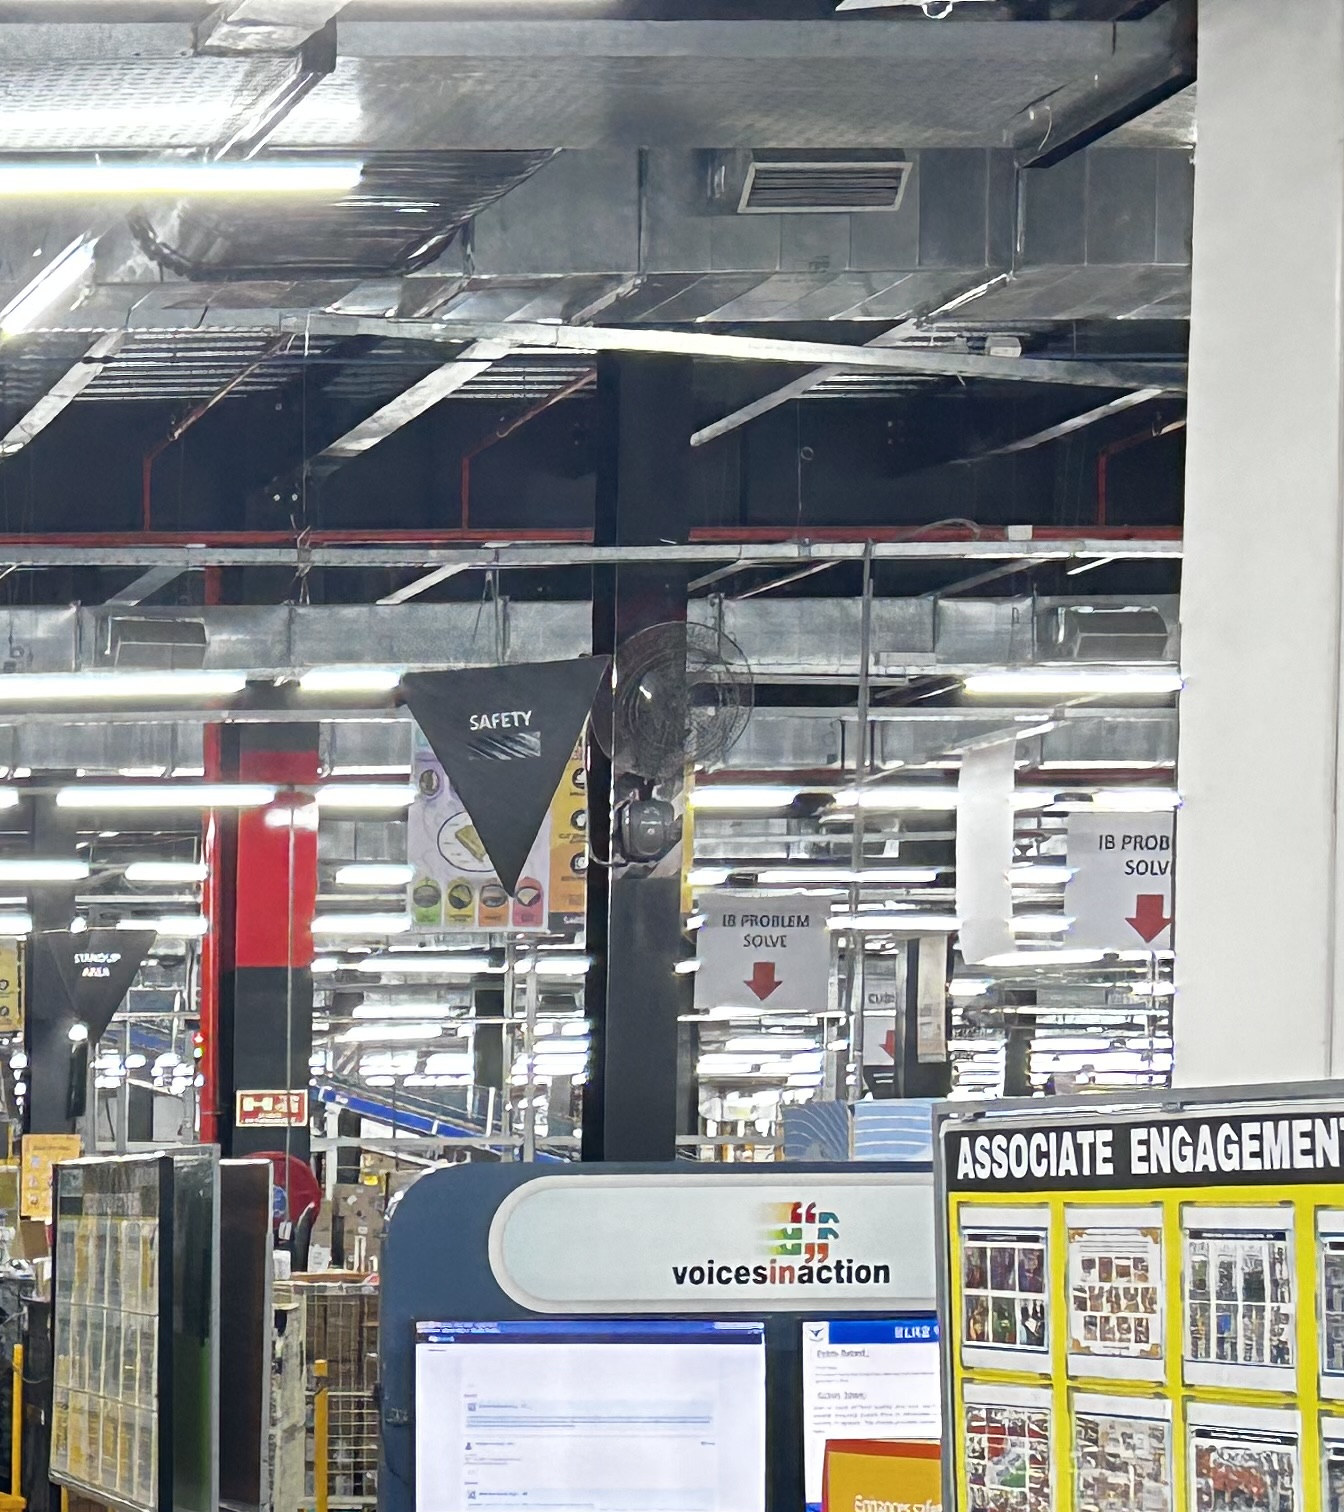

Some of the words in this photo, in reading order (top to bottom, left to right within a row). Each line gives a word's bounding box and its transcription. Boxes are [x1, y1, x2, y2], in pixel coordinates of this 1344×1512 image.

[469, 710, 532, 731] SAFETY
[1098, 834, 1115, 851] IB
[1121, 834, 1170, 852] PROB
[1124, 859, 1170, 876] SOLV
[722, 914, 736, 928] IB
[740, 914, 810, 928] PROBLEM
[743, 934, 788, 948] SOLVE
[956, 1129, 1114, 1180] ASSOCIATE
[671, 1258, 891, 1285] voicesinaction
